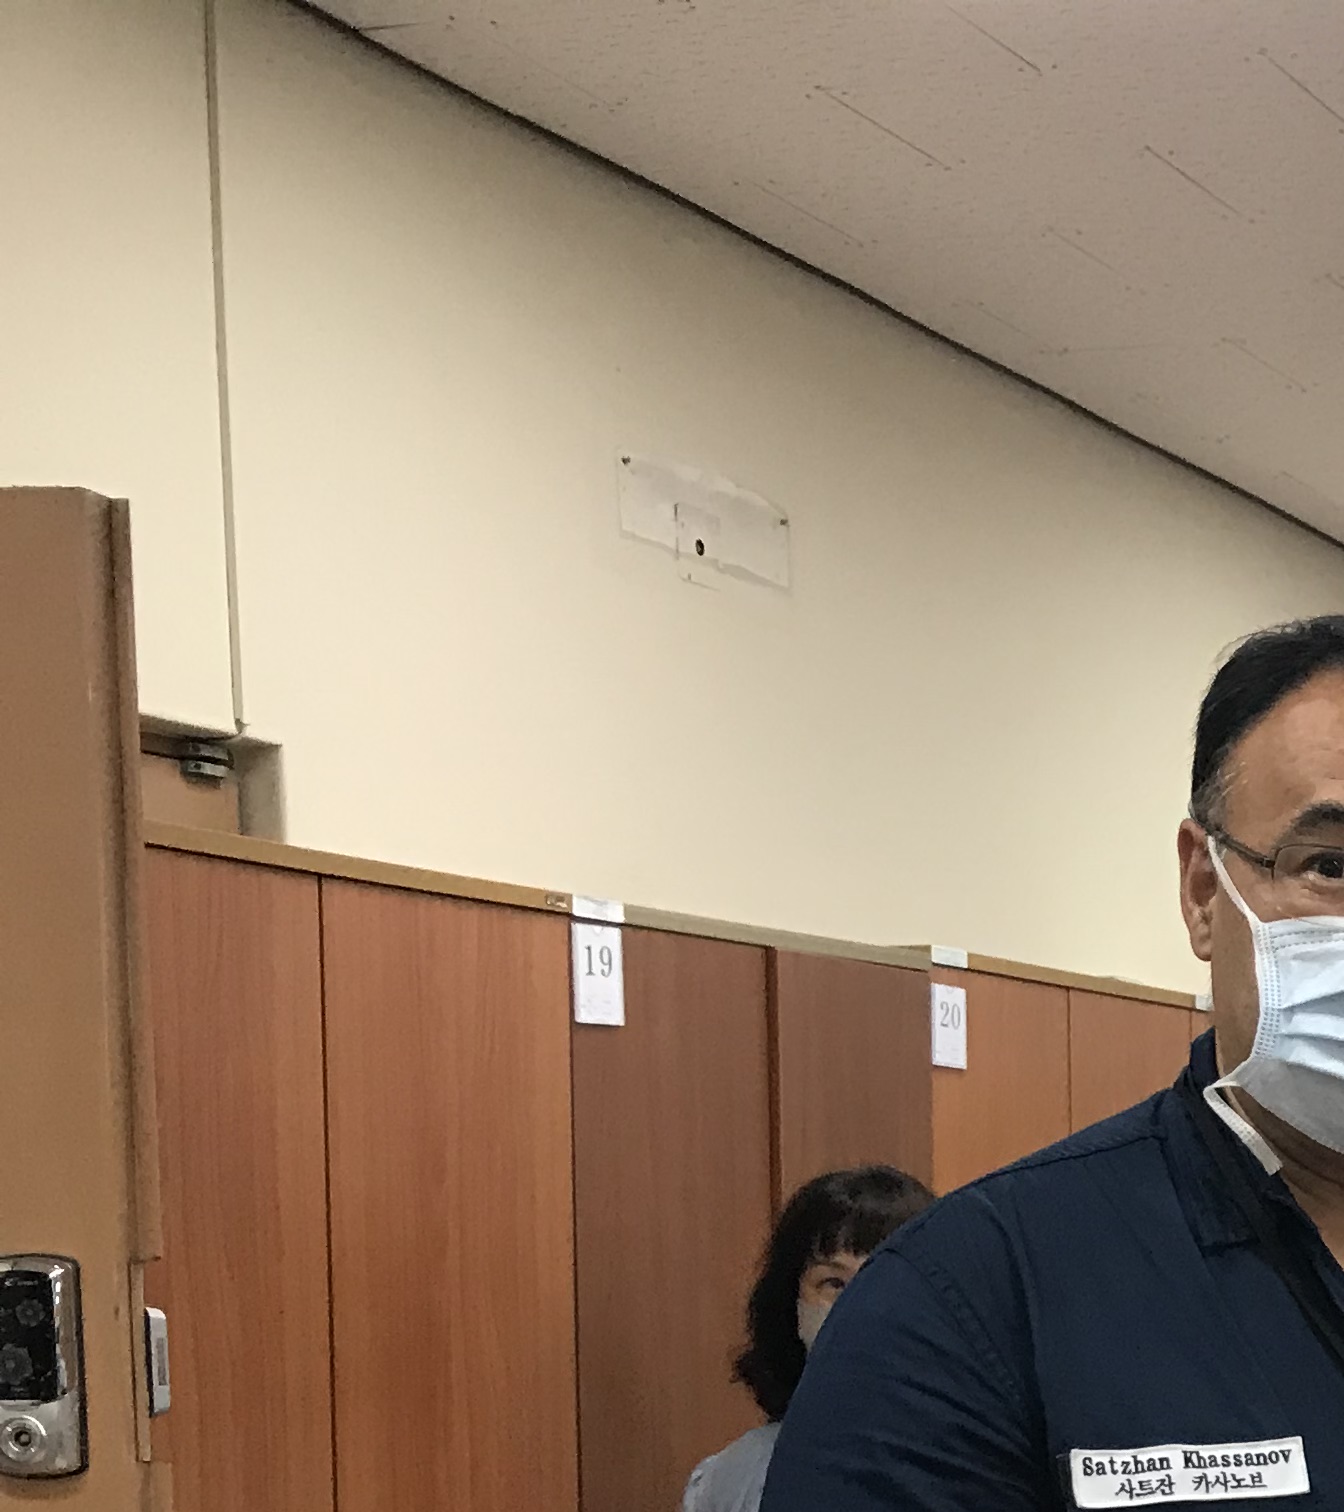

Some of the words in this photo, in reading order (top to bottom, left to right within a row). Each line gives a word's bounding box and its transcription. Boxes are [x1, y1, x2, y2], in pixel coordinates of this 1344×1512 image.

[584, 944, 613, 978] 19
[939, 1001, 961, 1031] 20
[1082, 1453, 1172, 1477] Satzhan
[1182, 1449, 1292, 1470] Khassanov
[1115, 1474, 1176, 1500] 사트잔
[1192, 1471, 1268, 1494] 카사노브
